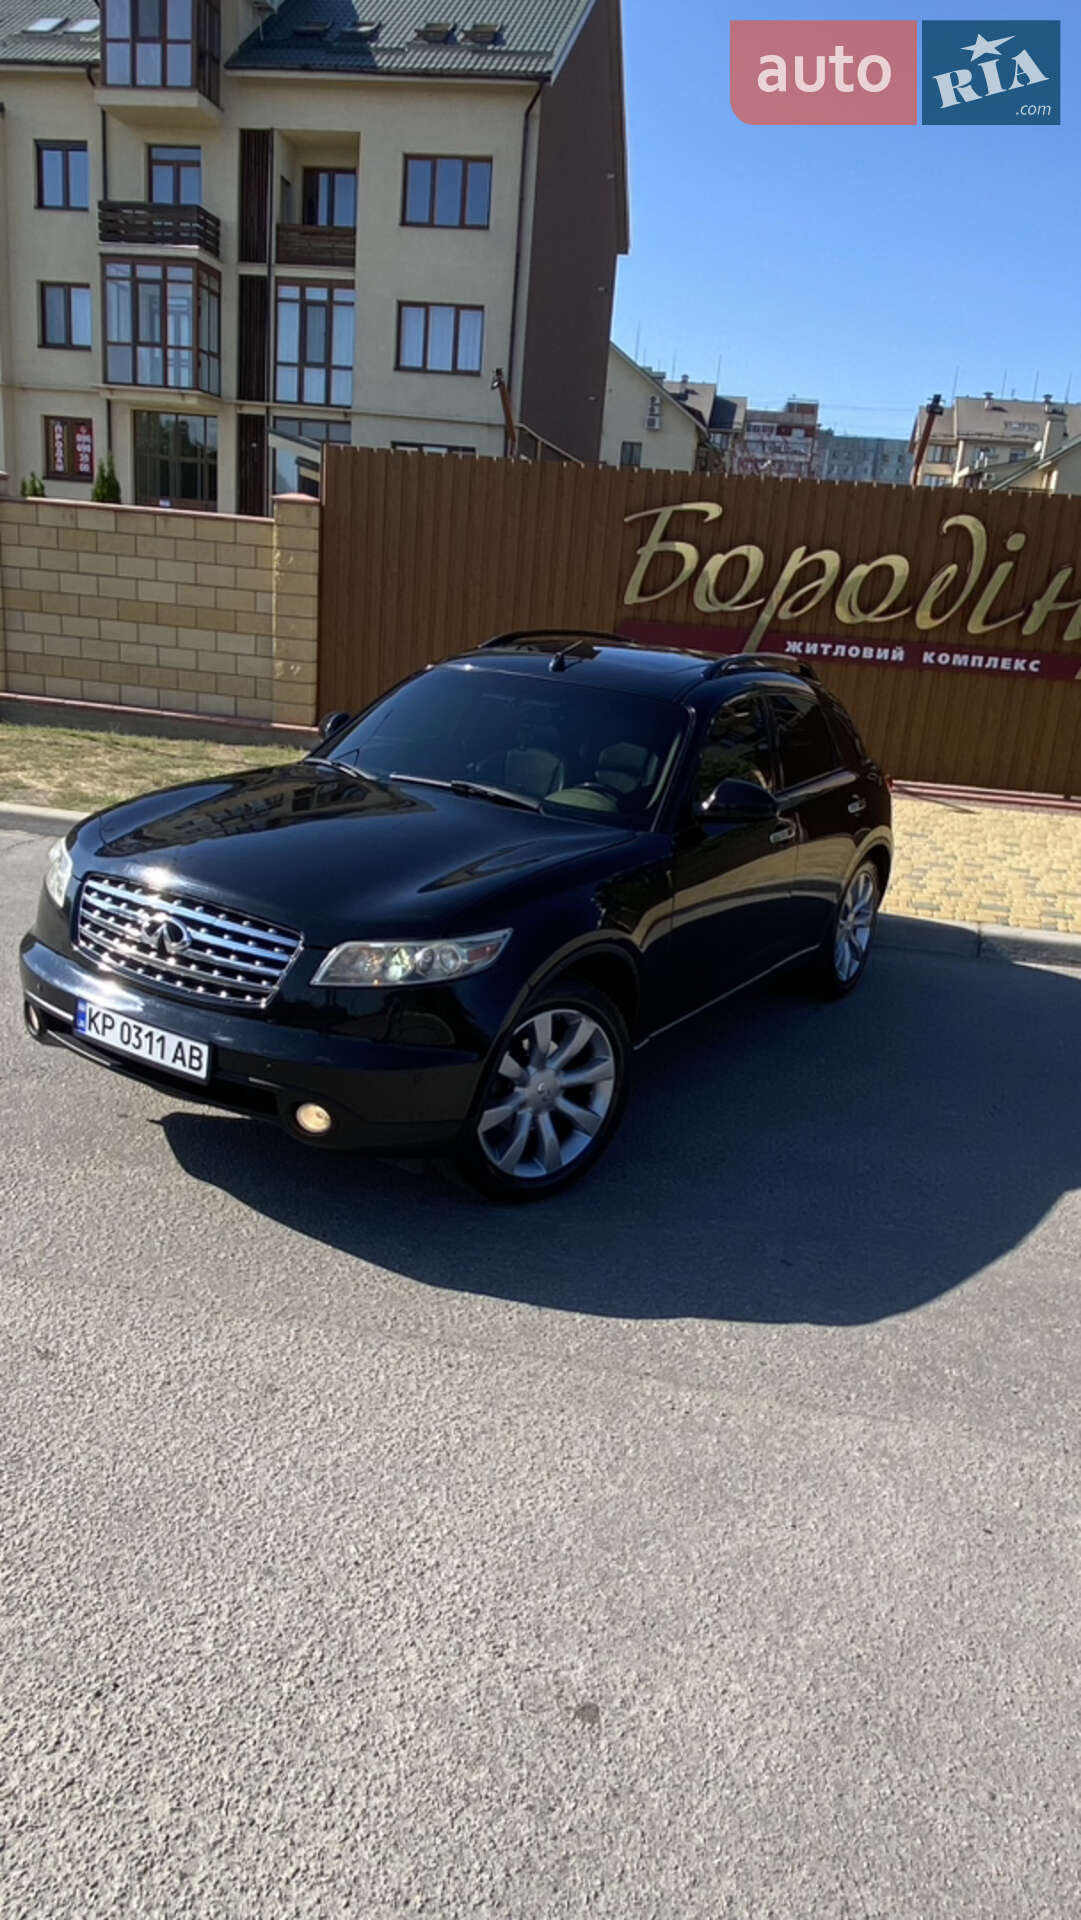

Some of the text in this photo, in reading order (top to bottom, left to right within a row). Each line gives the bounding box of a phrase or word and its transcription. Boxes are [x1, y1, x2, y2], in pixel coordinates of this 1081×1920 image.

[785, 639, 1041, 673] ЖИТЛОВИЙ КОМПЛЕКС
[88, 1007, 115, 1036] KP
[120, 1021, 166, 1060] 0311
[172, 1041, 203, 1071] AB
